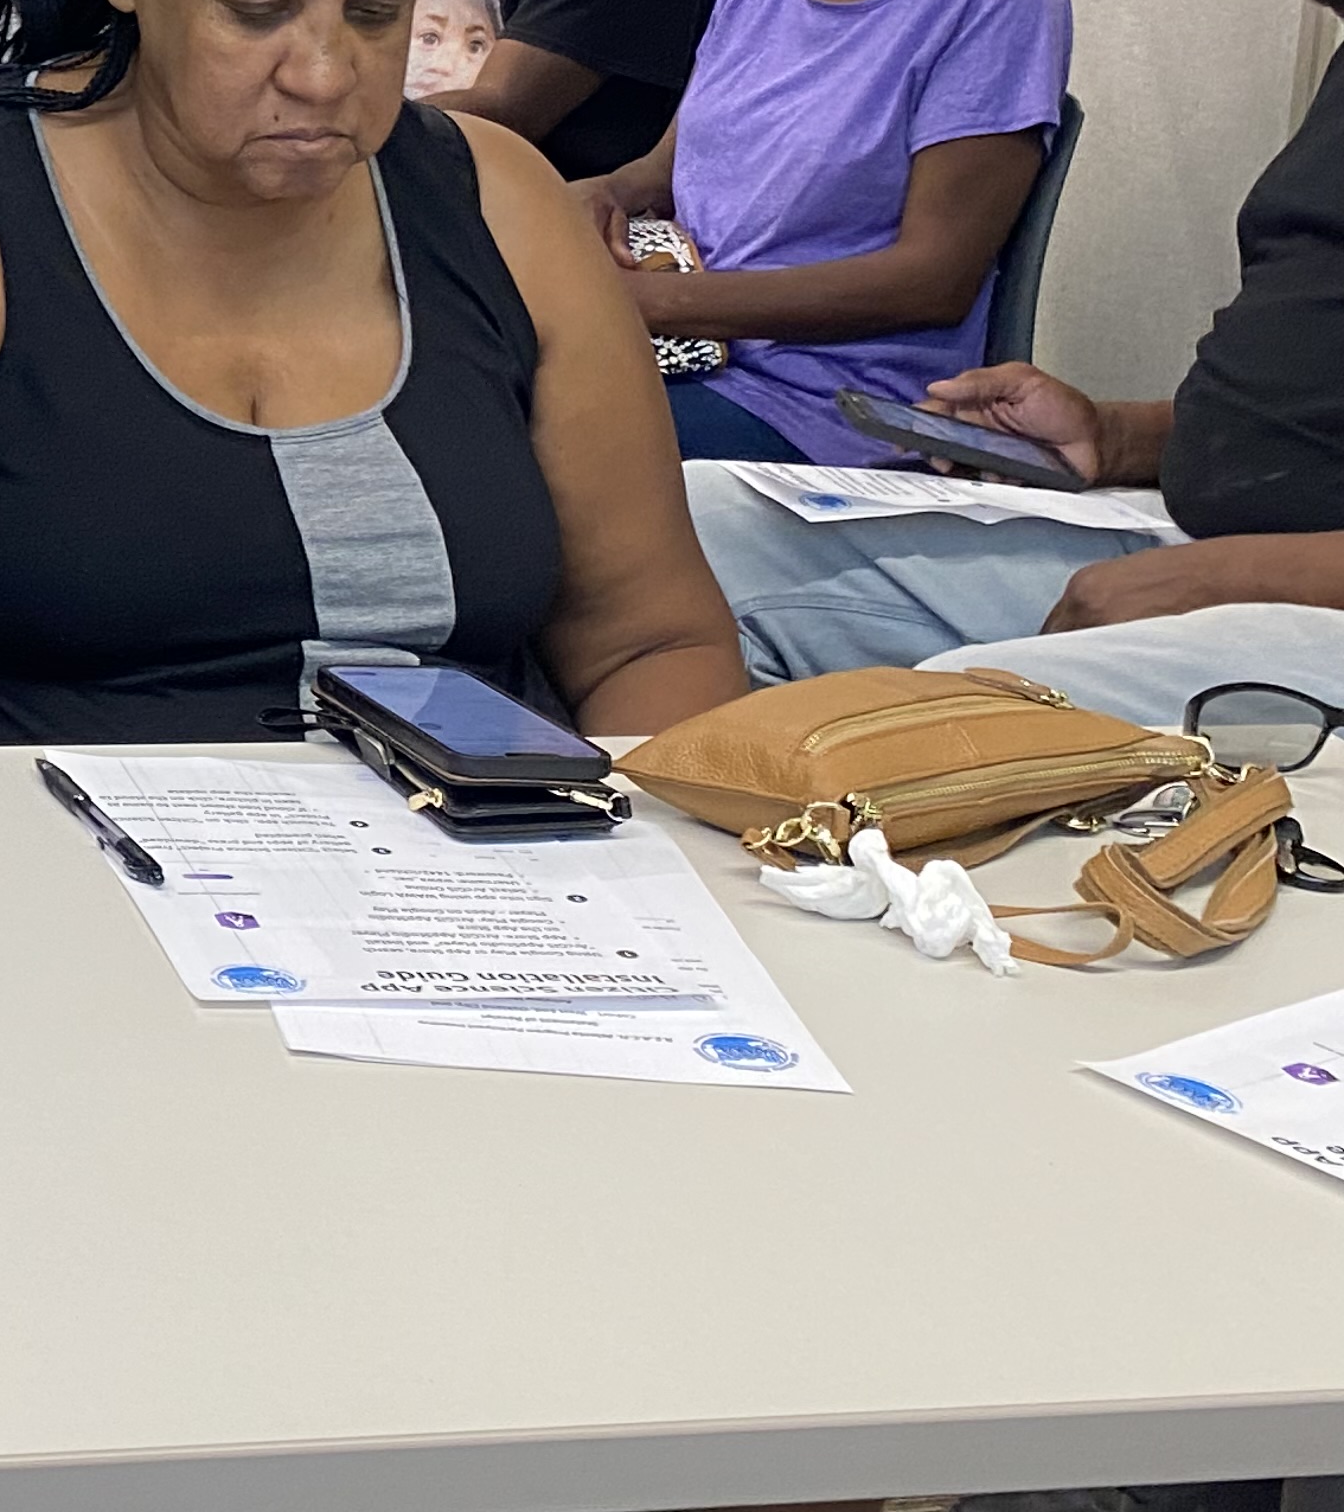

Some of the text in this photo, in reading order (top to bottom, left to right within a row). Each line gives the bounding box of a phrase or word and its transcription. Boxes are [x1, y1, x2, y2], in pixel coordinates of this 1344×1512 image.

[376, 970, 663, 984] Installation Guide
[360, 982, 422, 993] App
[433, 985, 557, 993] Science
[1272, 1136, 1344, 1167] App
